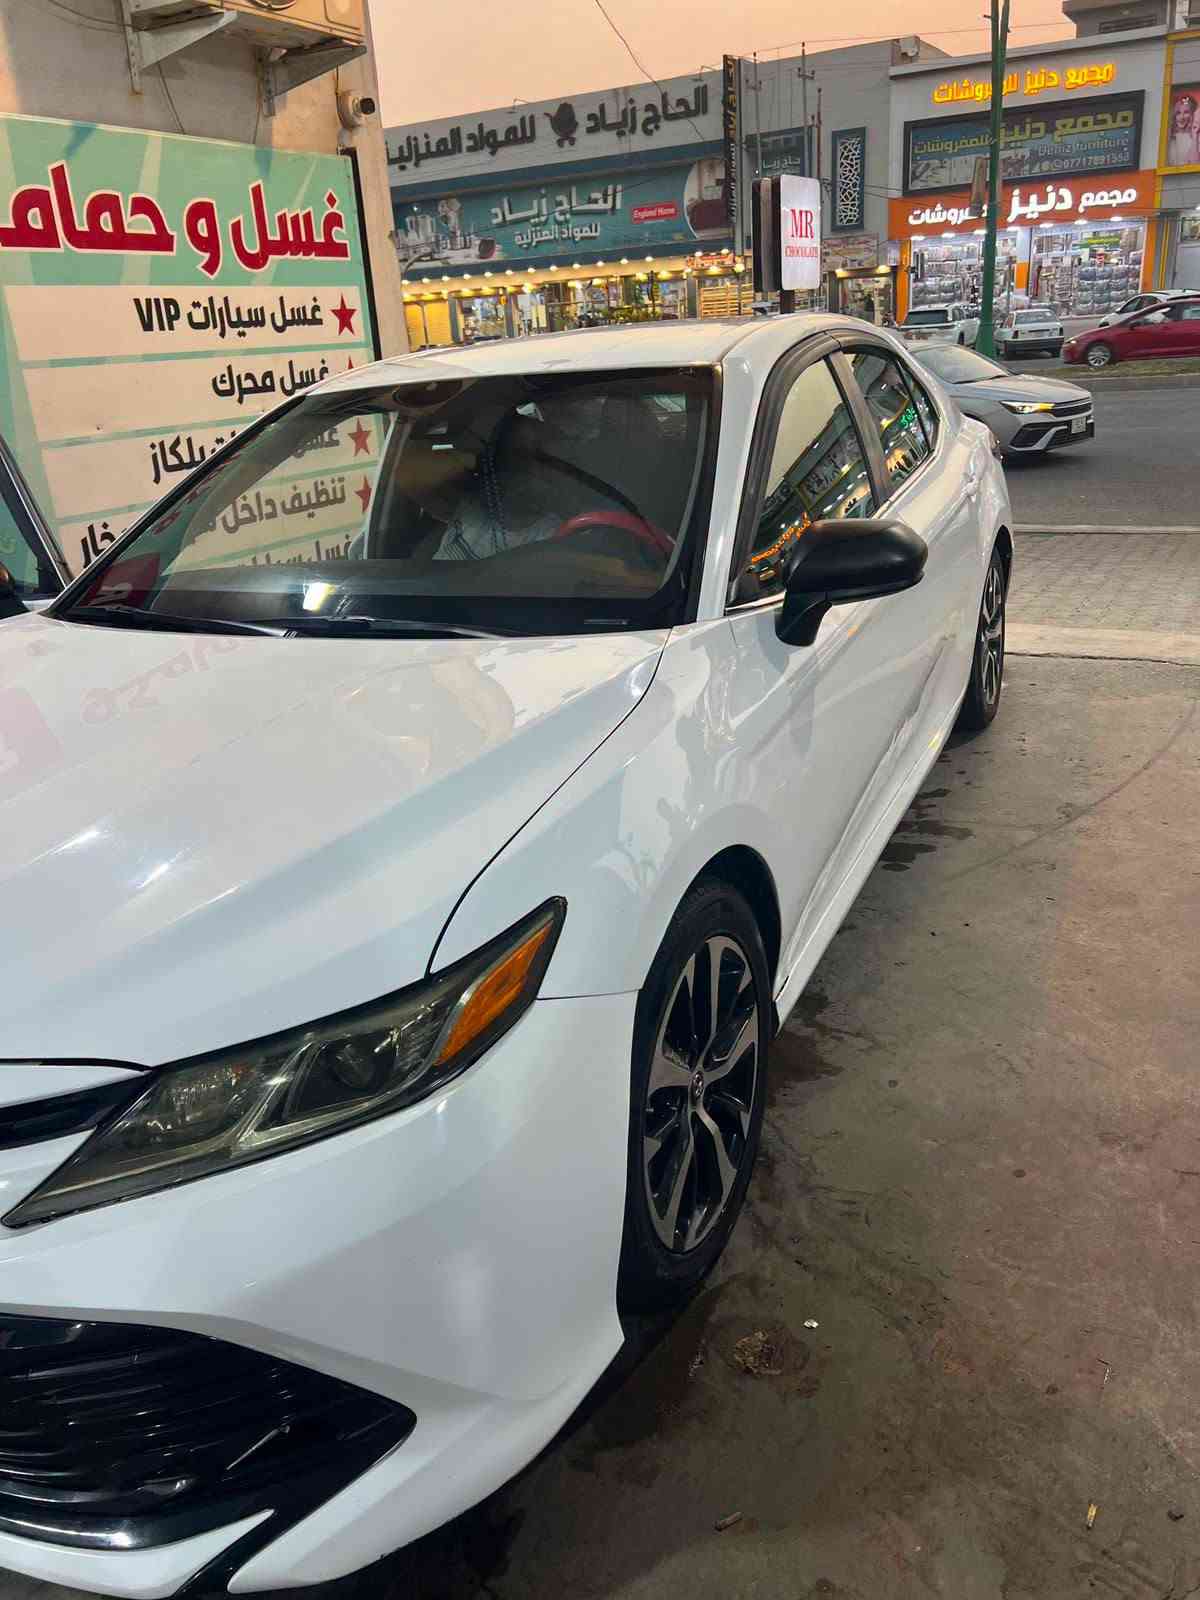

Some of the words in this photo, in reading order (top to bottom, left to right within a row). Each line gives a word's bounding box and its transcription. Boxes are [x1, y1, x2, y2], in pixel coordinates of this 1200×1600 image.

[933, 72, 1019, 103] للروشات
[1023, 65, 1060, 96] دنيز
[1063, 63, 1115, 90] مجمع
[586, 97, 637, 137] زياد
[642, 84, 708, 136] الحاج
[1053, 110, 1136, 144] مجمع
[384, 126, 464, 170] المنزلي
[465, 114, 537, 157] للمواد
[0, 160, 175, 253] حمام
[489, 188, 548, 225] زياد
[555, 184, 623, 222] الحاج
[1006, 185, 1073, 222] دنيز
[1077, 187, 1137, 212] مجمع
[185, 199, 222, 278] و
[230, 180, 350, 271] غسل
[514, 224, 559, 248] المنزلية
[560, 221, 601, 242] للمواد
[790, 208, 814, 239] MR
[784, 246, 818, 258] CHOCOLATE
[133, 296, 181, 333] VIP
[187, 299, 266, 338] سيارات
[271, 296, 324, 332] غسل
[211, 364, 276, 406] محرك
[221, 490, 279, 534] داخل
[281, 476, 347, 519] تنظيف
